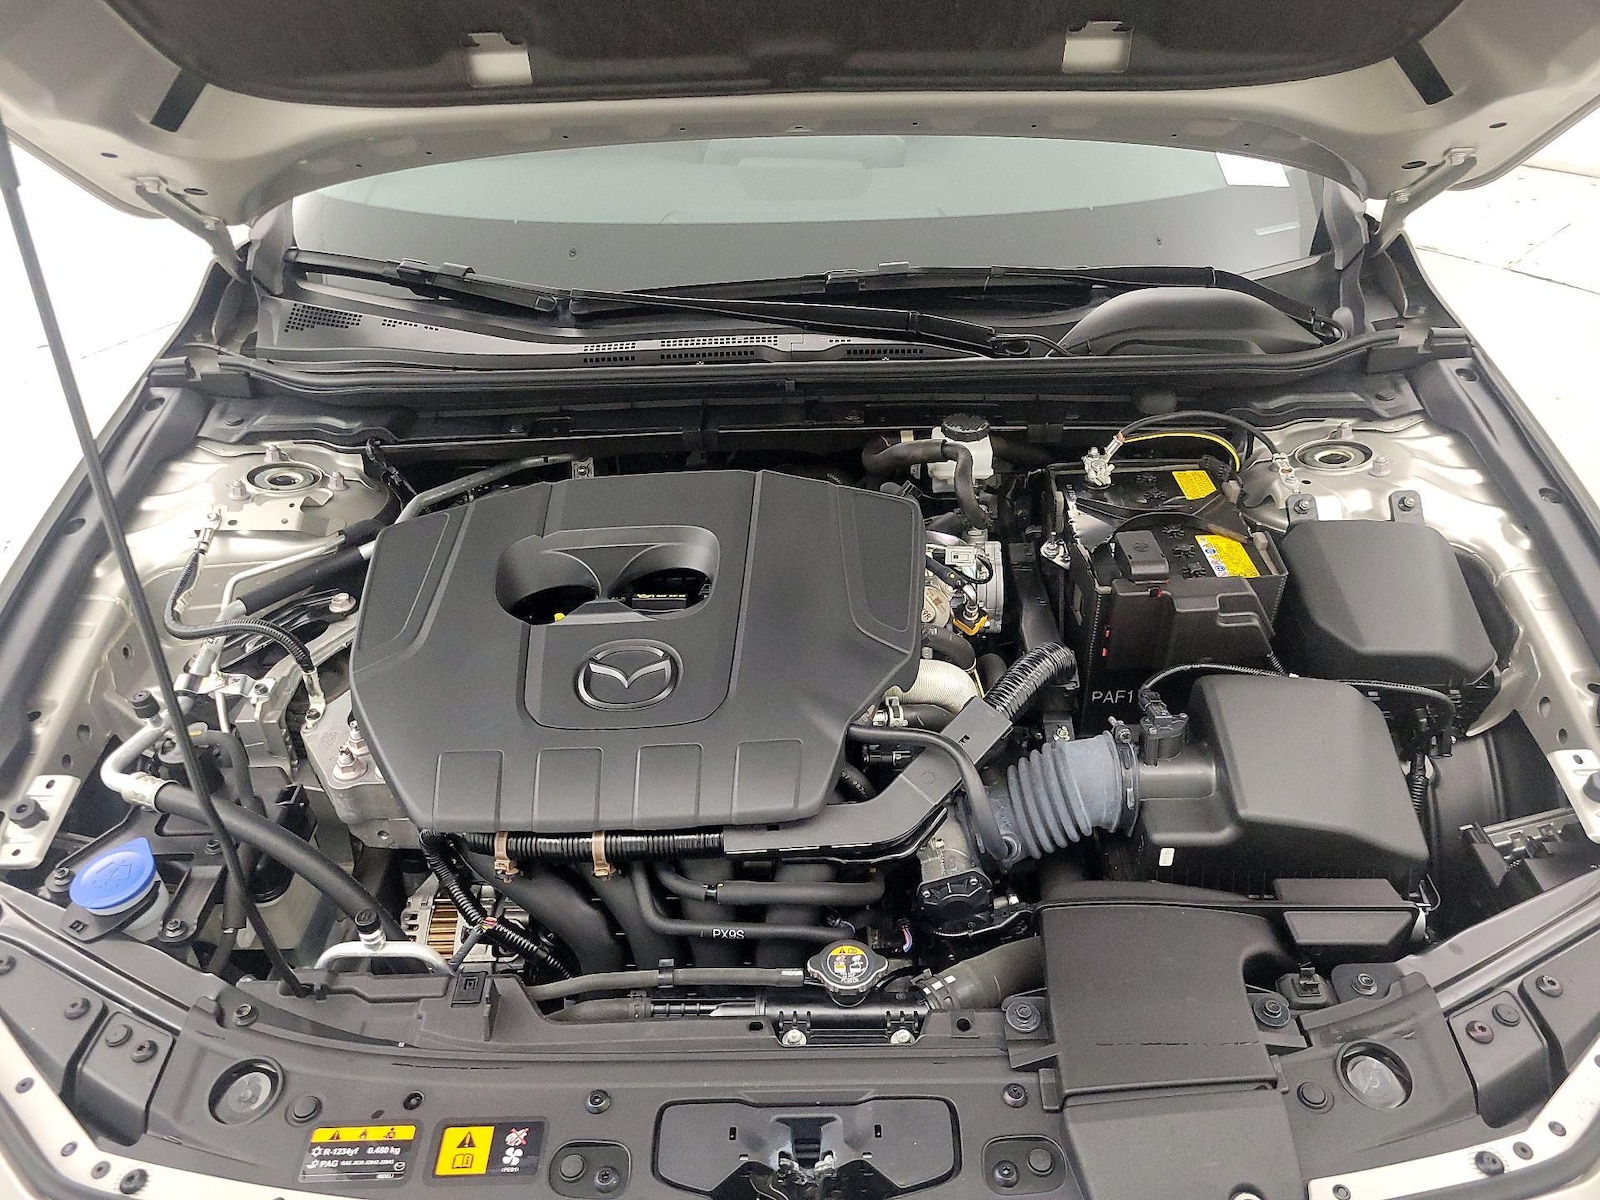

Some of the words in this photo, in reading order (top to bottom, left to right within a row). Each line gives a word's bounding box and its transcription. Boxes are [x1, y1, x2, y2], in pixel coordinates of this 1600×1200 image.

[1091, 690, 1134, 704] PAF1
[712, 928, 745, 940] PX9S
[322, 1147, 360, 1157] R-1234yf
[389, 1146, 401, 1156] kg
[319, 1160, 339, 1168] PAG
